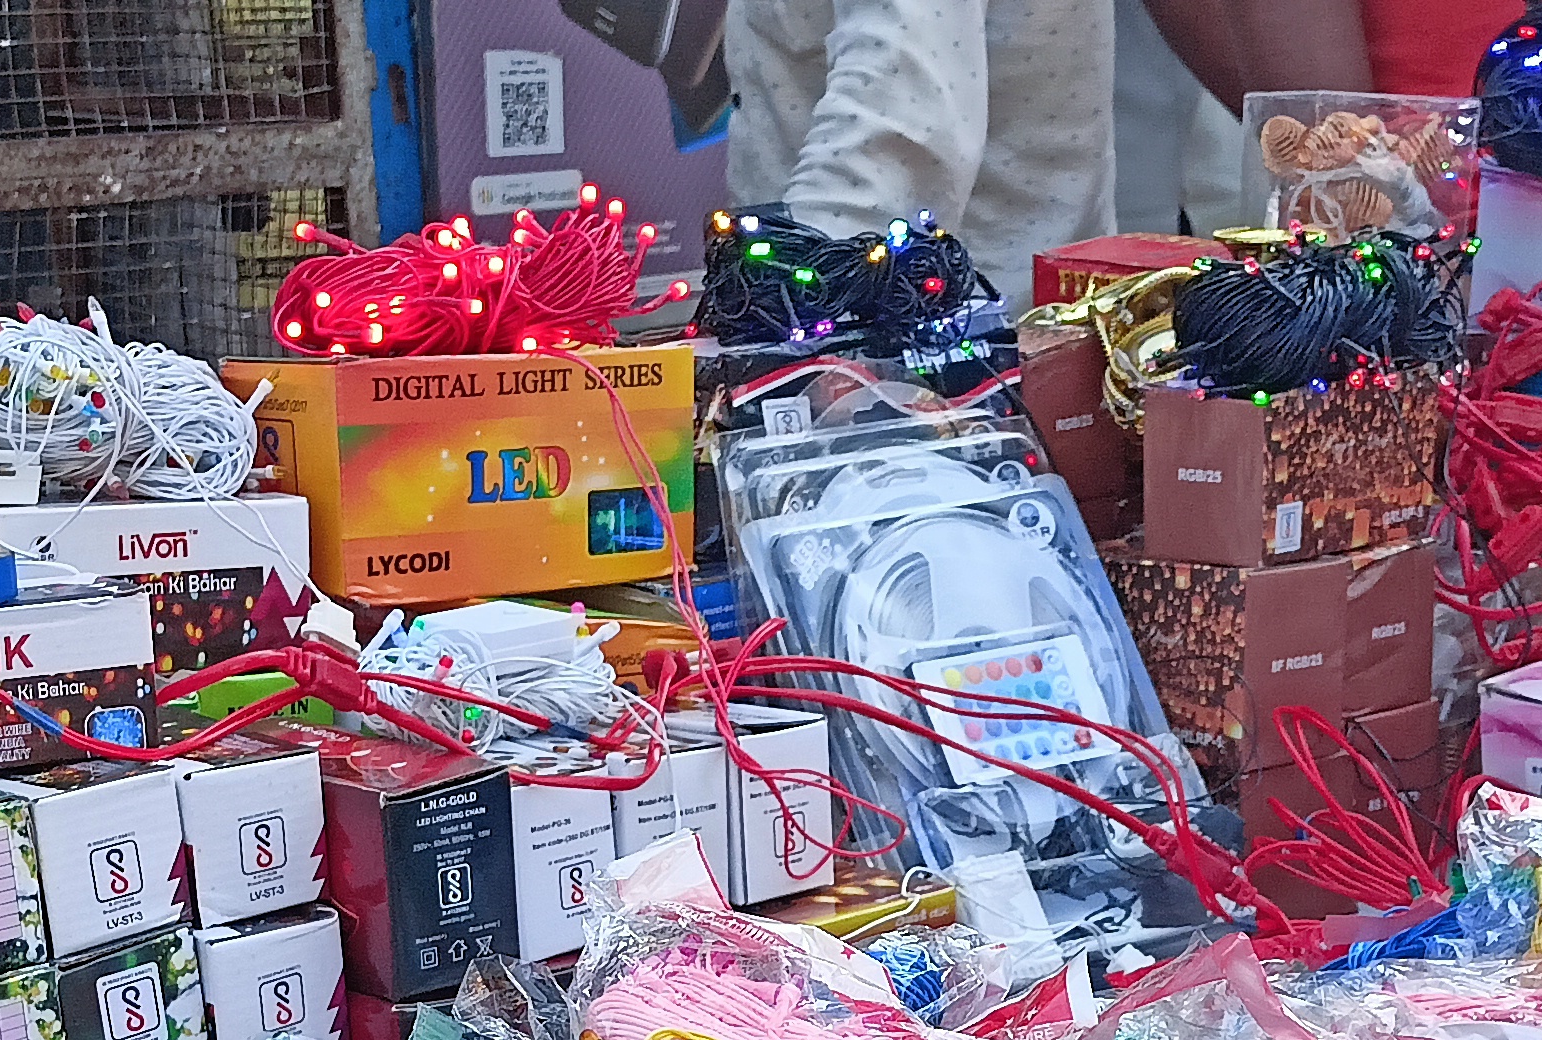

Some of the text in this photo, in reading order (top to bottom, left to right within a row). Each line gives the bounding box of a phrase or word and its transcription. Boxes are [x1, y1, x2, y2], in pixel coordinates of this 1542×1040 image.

[372, 363, 664, 402] DIGITAL LIGHT SERIES
[466, 445, 572, 503] LED
[118, 531, 189, 561] LiVon
[366, 551, 451, 577] LYCODI
[169, 576, 185, 594] Ki
[18, 680, 87, 701] Ki Bahar
[5, 723, 33, 737] WIRE
[249, 884, 285, 902] LV-ST-3
[106, 912, 145, 930] LV-ST-3
